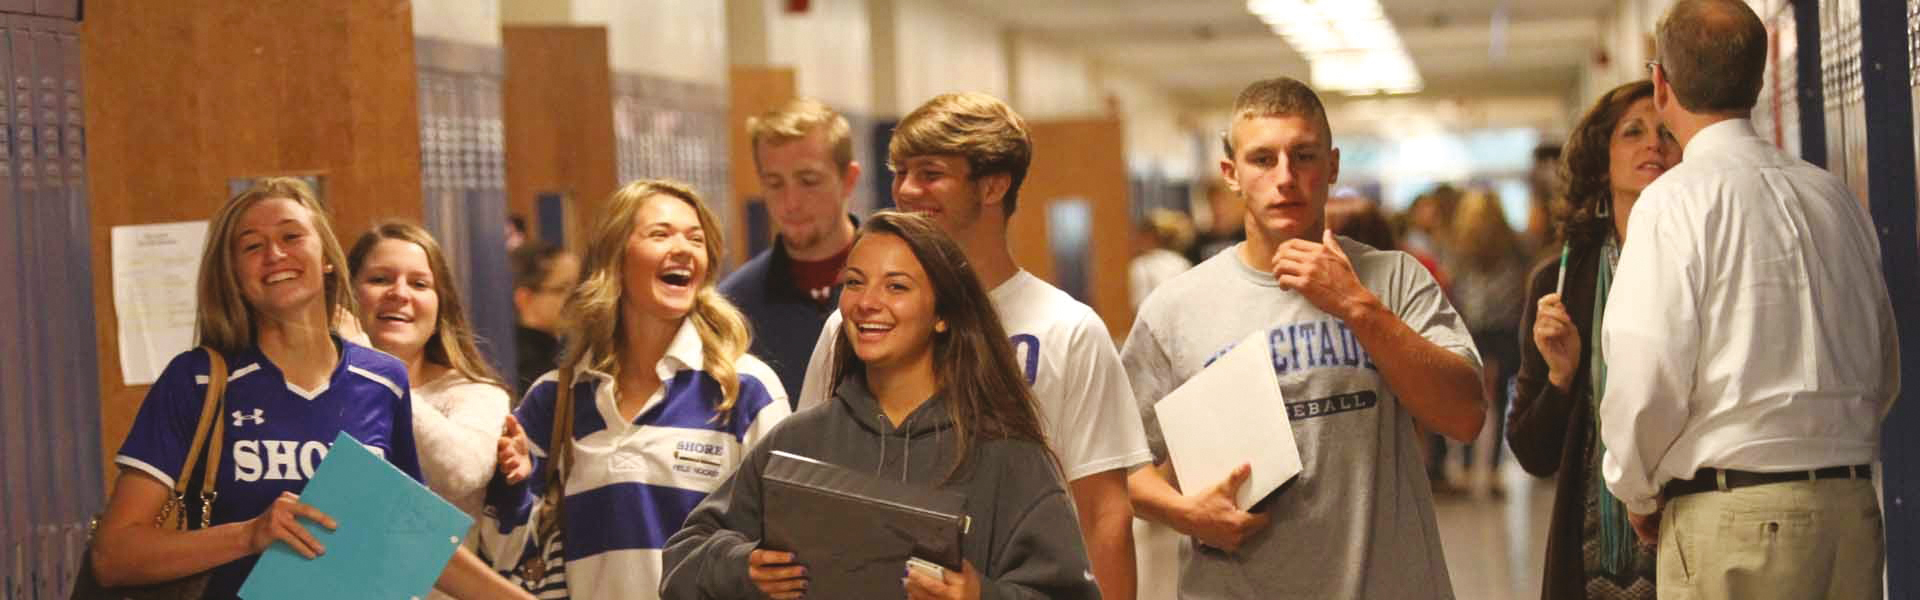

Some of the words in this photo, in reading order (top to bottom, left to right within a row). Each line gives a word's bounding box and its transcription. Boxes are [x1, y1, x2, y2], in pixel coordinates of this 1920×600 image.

[1269, 320, 1377, 374] CITAD
[1286, 394, 1367, 418] EBALL
[233, 439, 385, 482] SHO
[676, 441, 723, 456] SHORE
